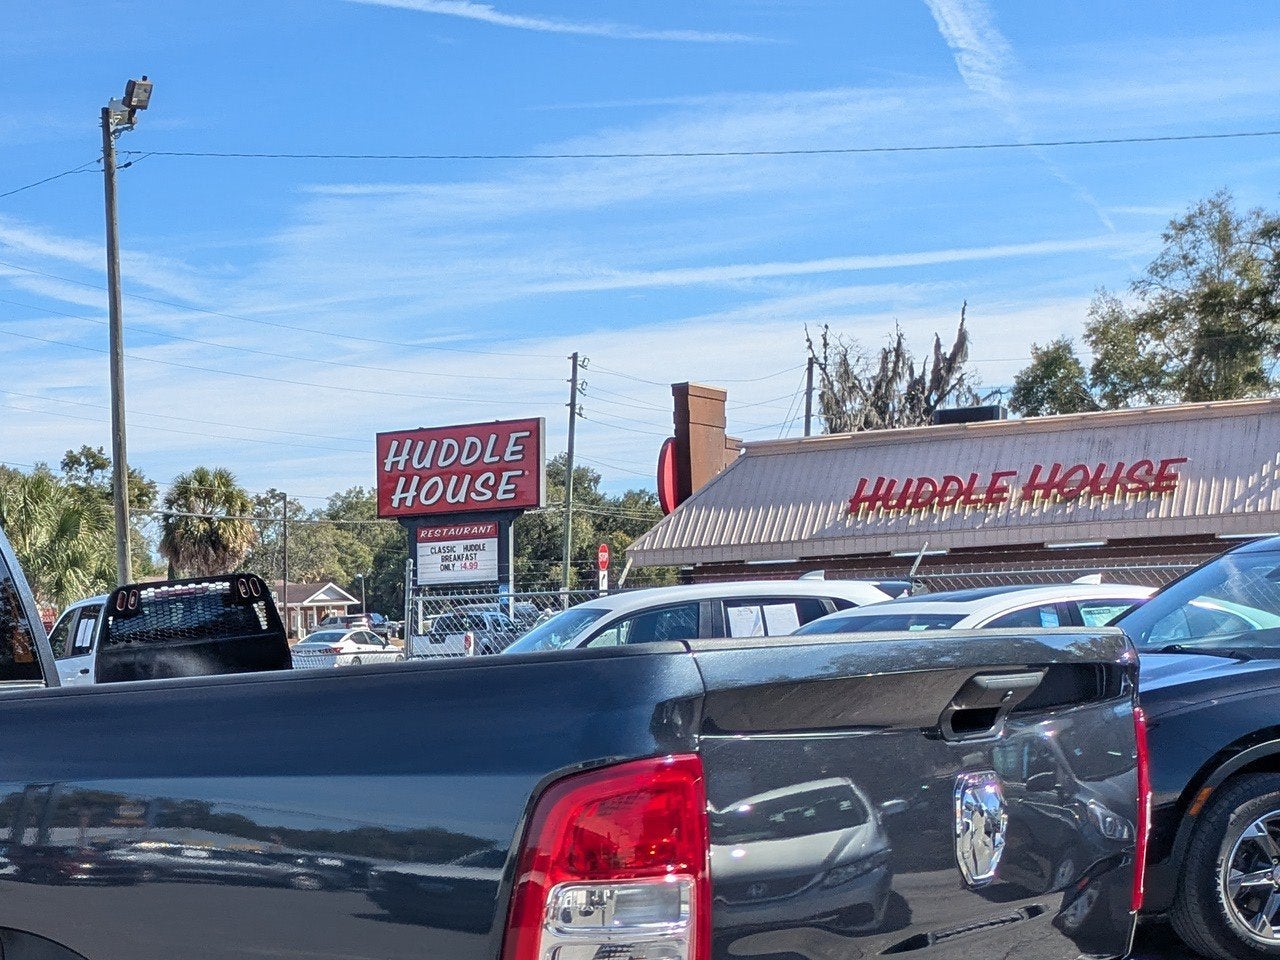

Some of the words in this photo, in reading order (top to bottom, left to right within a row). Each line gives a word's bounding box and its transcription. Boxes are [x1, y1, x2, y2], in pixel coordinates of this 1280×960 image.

[383, 431, 531, 472] HUDDLE
[391, 470, 523, 508] HOUSE
[848, 470, 1018, 514] HUDDLE
[1021, 457, 1189, 501] HOUSE
[420, 525, 494, 538] RESTAURANT
[430, 545, 457, 555] CLASSIC
[463, 543, 486, 553] HUDDLE
[440, 553, 478, 563] BREAKFAST
[439, 563, 456, 572] ONLY
